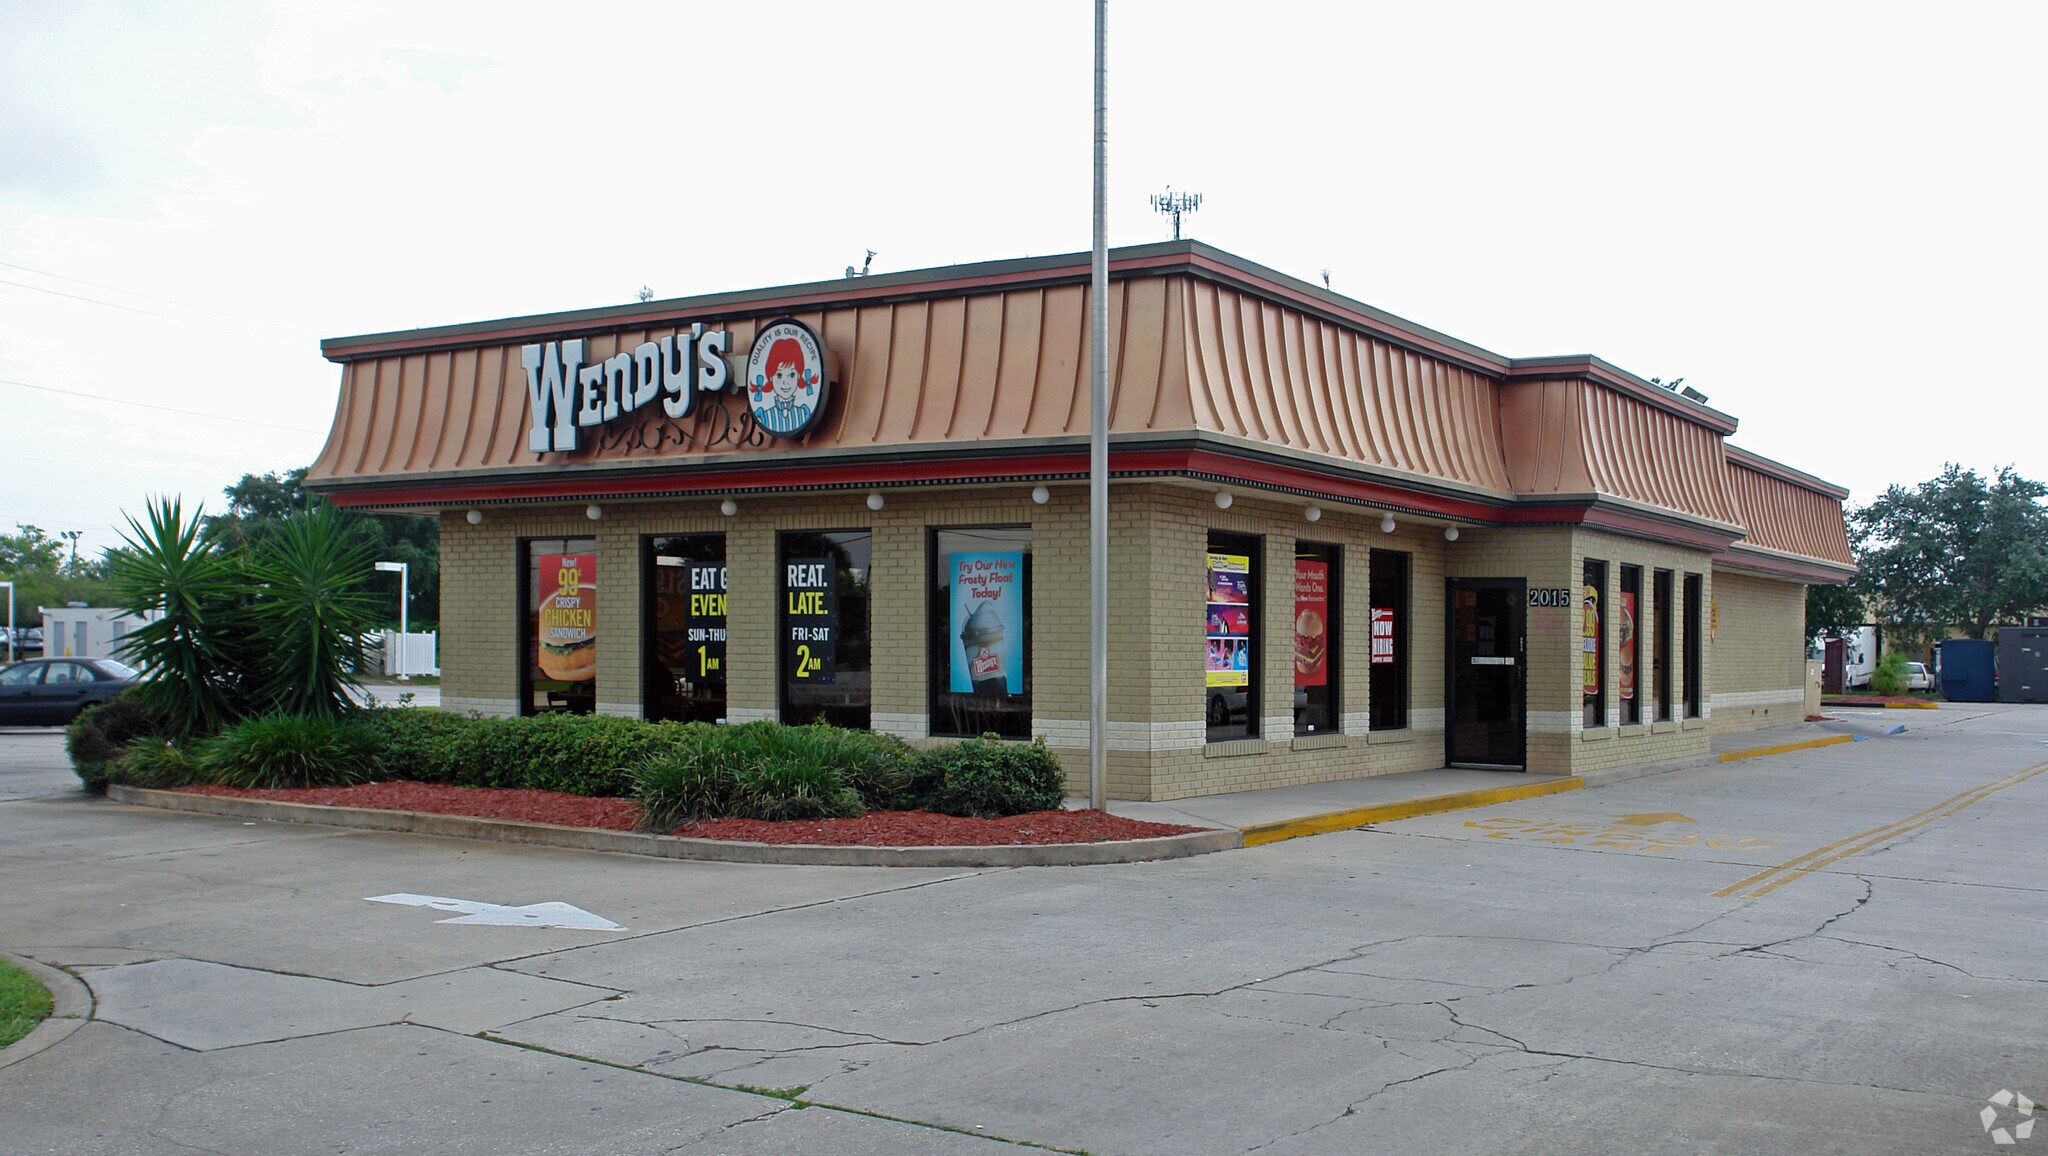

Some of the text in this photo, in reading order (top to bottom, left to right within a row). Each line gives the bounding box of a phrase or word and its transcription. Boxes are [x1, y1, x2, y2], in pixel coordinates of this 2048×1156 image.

[752, 327, 817, 365] QUALITY IS OUR RECIPE
[561, 557, 577, 568] New!
[958, 559, 1015, 574] Try Our New
[691, 567, 717, 590] EAT
[787, 564, 828, 587] REAT.
[958, 571, 1013, 586] Frosty Float
[971, 587, 1002, 600] Today!
[1530, 590, 1569, 606] 2015
[555, 597, 581, 608] CRISPY
[789, 591, 828, 615] LATE.
[543, 609, 591, 627] CHICKEN
[549, 627, 586, 639] SANDWICH
[792, 627, 830, 641] FRI-SAT
[1373, 621, 1392, 636] NOW
